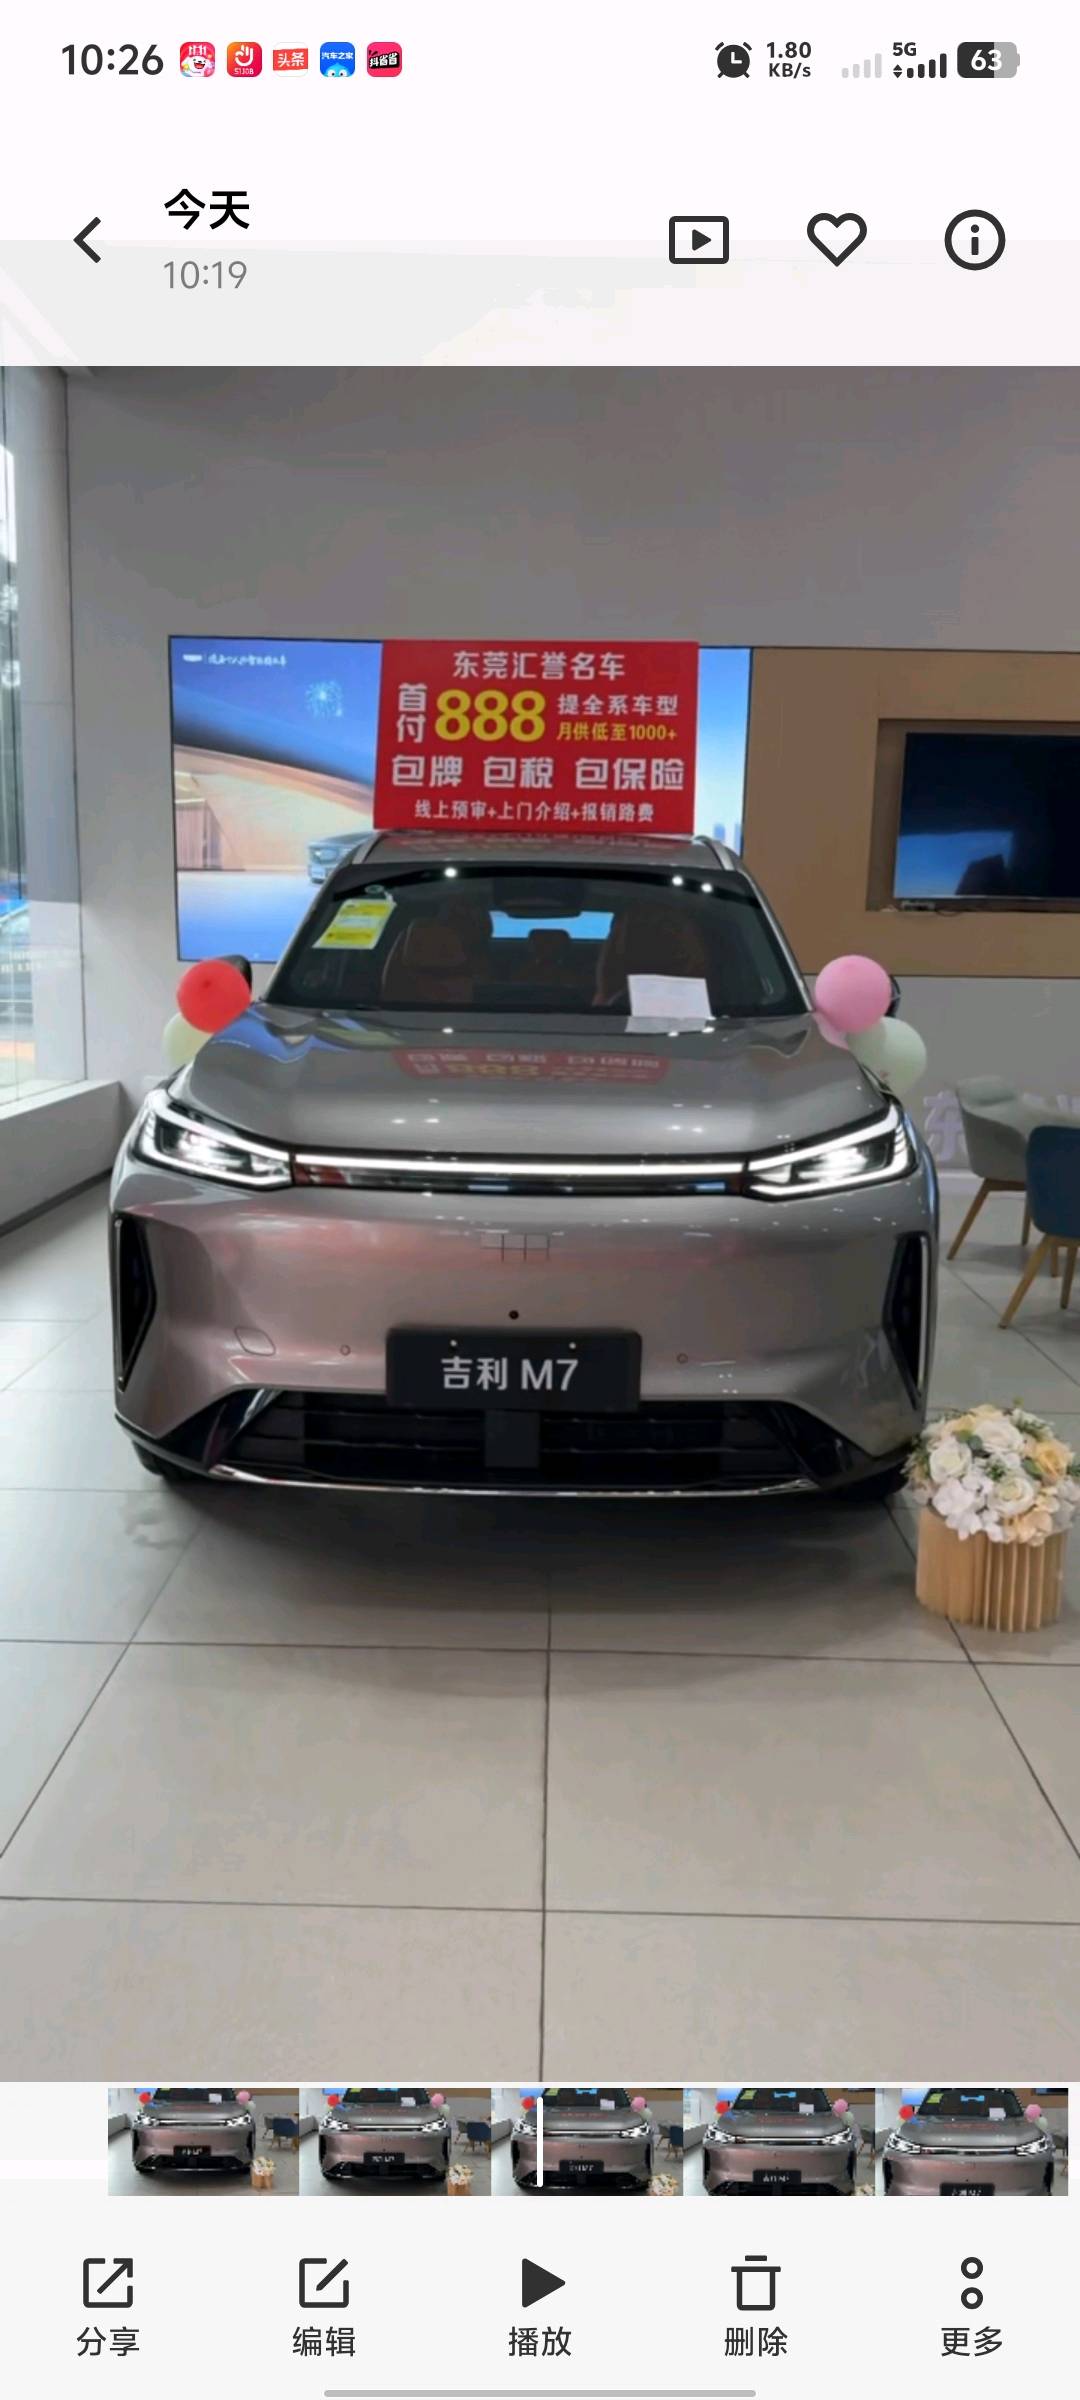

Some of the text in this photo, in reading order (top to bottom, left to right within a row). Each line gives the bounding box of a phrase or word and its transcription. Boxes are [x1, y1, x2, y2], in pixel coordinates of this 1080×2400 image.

[452, 650, 626, 680] 东莞汇誉名车
[396, 682, 428, 743] 首付
[434, 688, 547, 742] 888
[556, 693, 679, 716] 提全系车型
[556, 721, 678, 741] 月供低至1000+
[391, 754, 684, 791] 包牌 包税 包保险
[414, 799, 655, 823] 线上预审+上门介绍+报销路费
[441, 1355, 579, 1391] 吉利 M7
